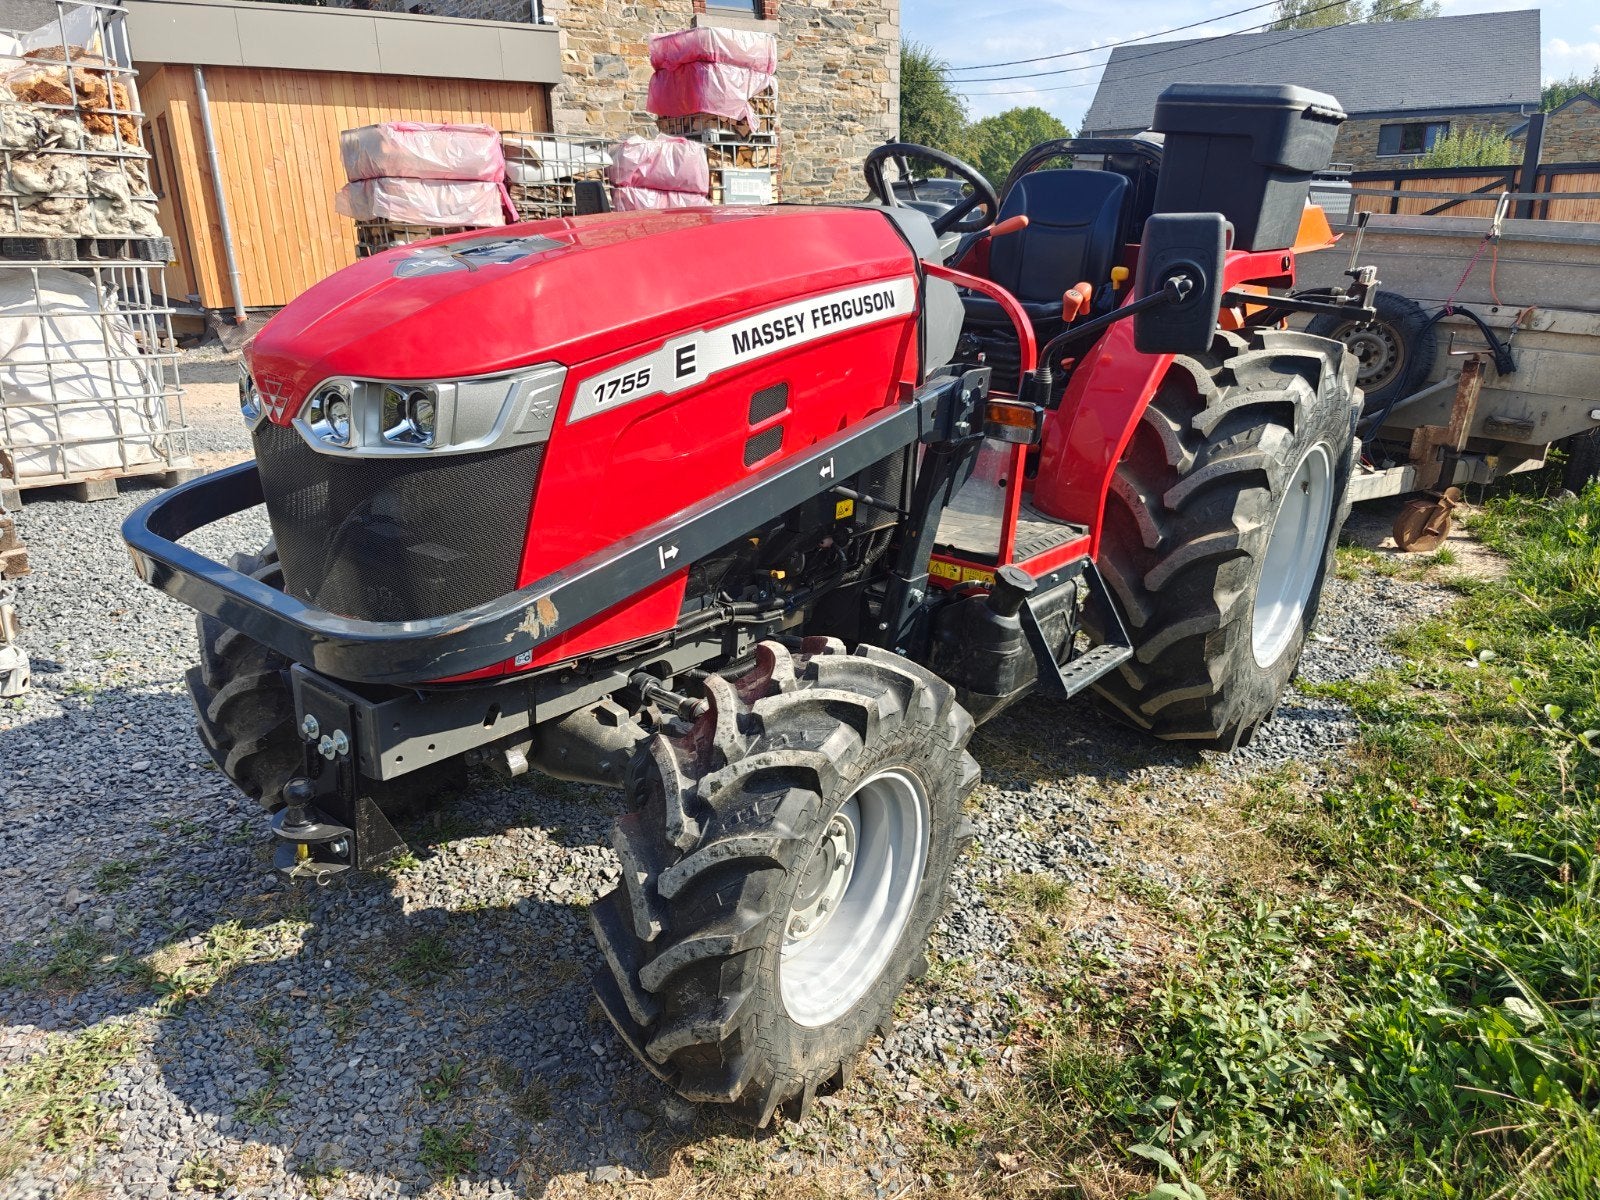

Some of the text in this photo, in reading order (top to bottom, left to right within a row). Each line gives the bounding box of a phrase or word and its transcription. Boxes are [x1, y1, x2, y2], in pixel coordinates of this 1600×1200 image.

[594, 289, 895, 403] 1755 E MASSEY FERGUSON
